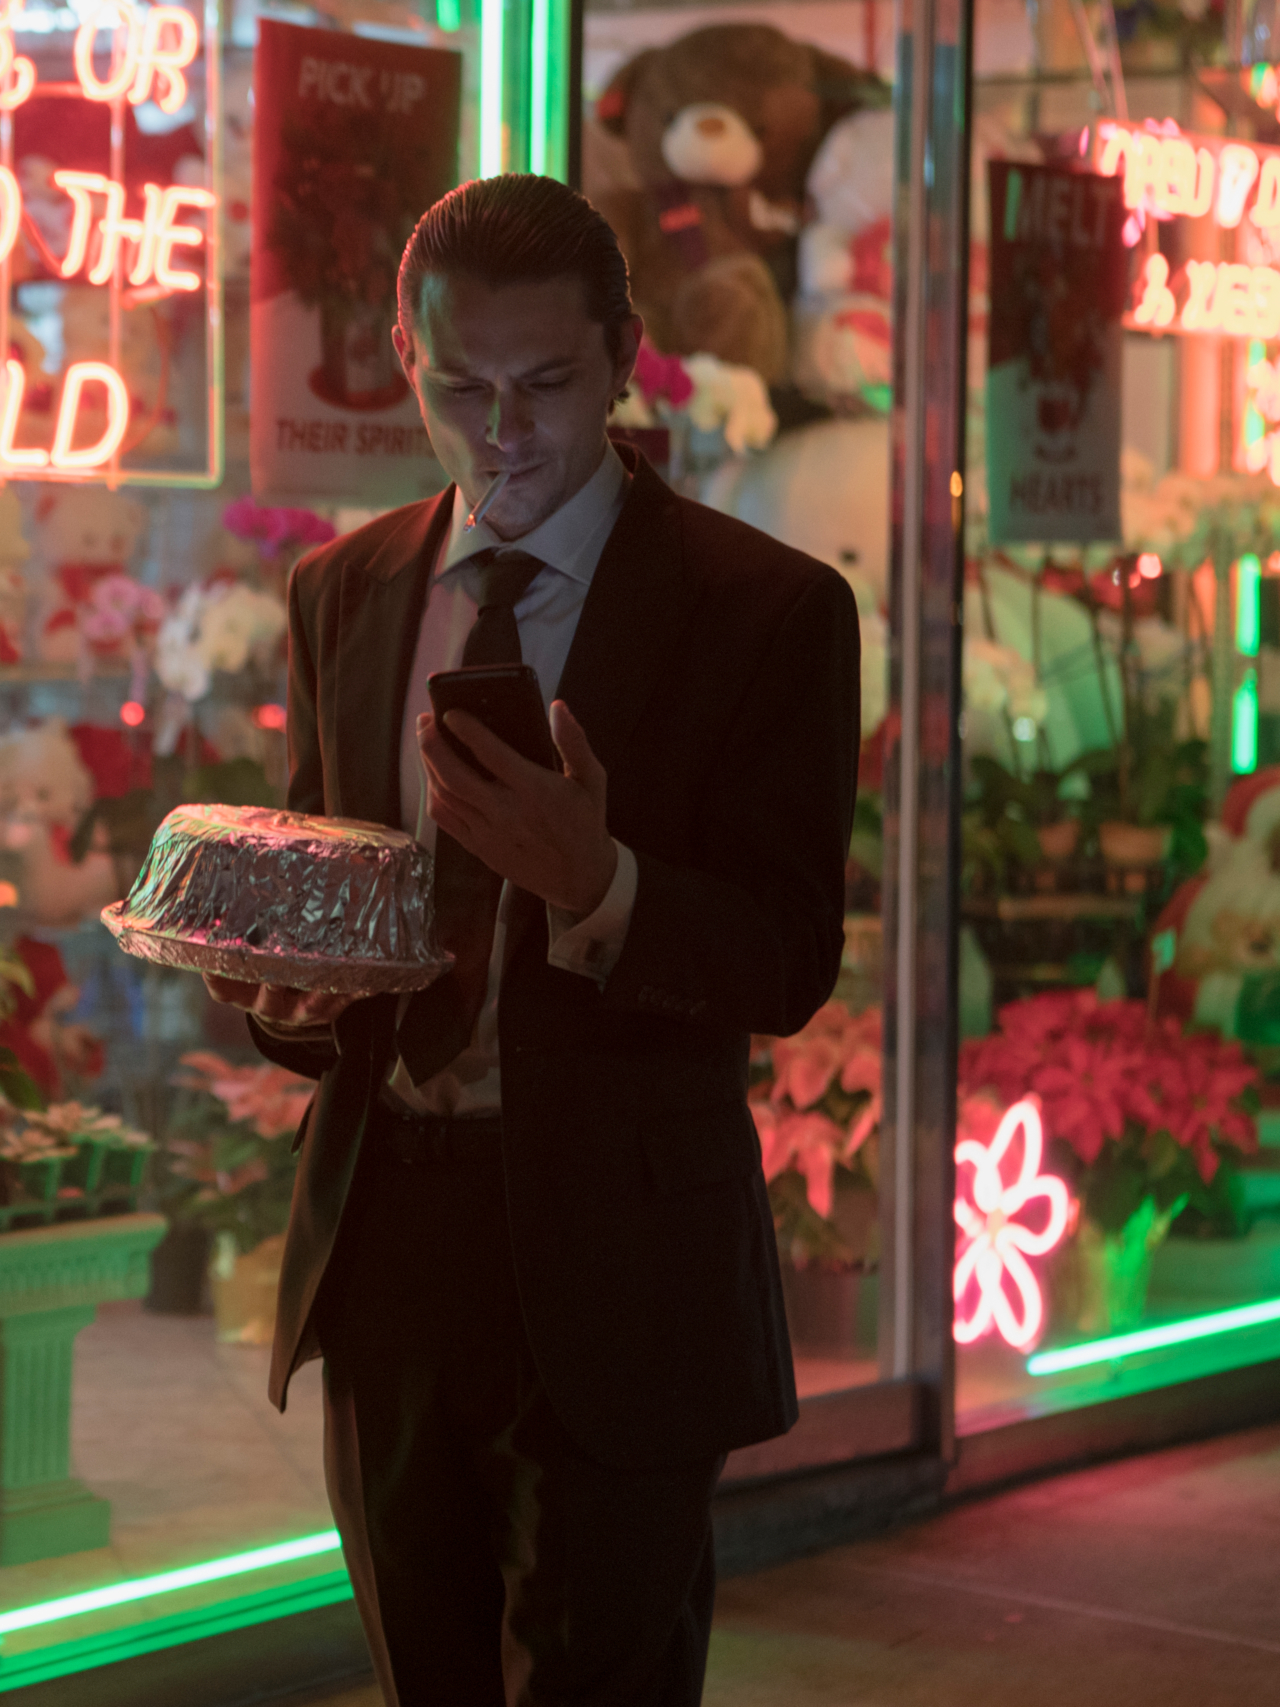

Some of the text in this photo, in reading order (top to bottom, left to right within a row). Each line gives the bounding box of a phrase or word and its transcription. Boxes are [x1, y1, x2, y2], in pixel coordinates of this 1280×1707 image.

[76, 0, 199, 113] OR
[298, 57, 426, 115] PICK UP
[55, 170, 216, 291] THE
[1004, 168, 1114, 247] MELT
[276, 419, 348, 454] THEIR
